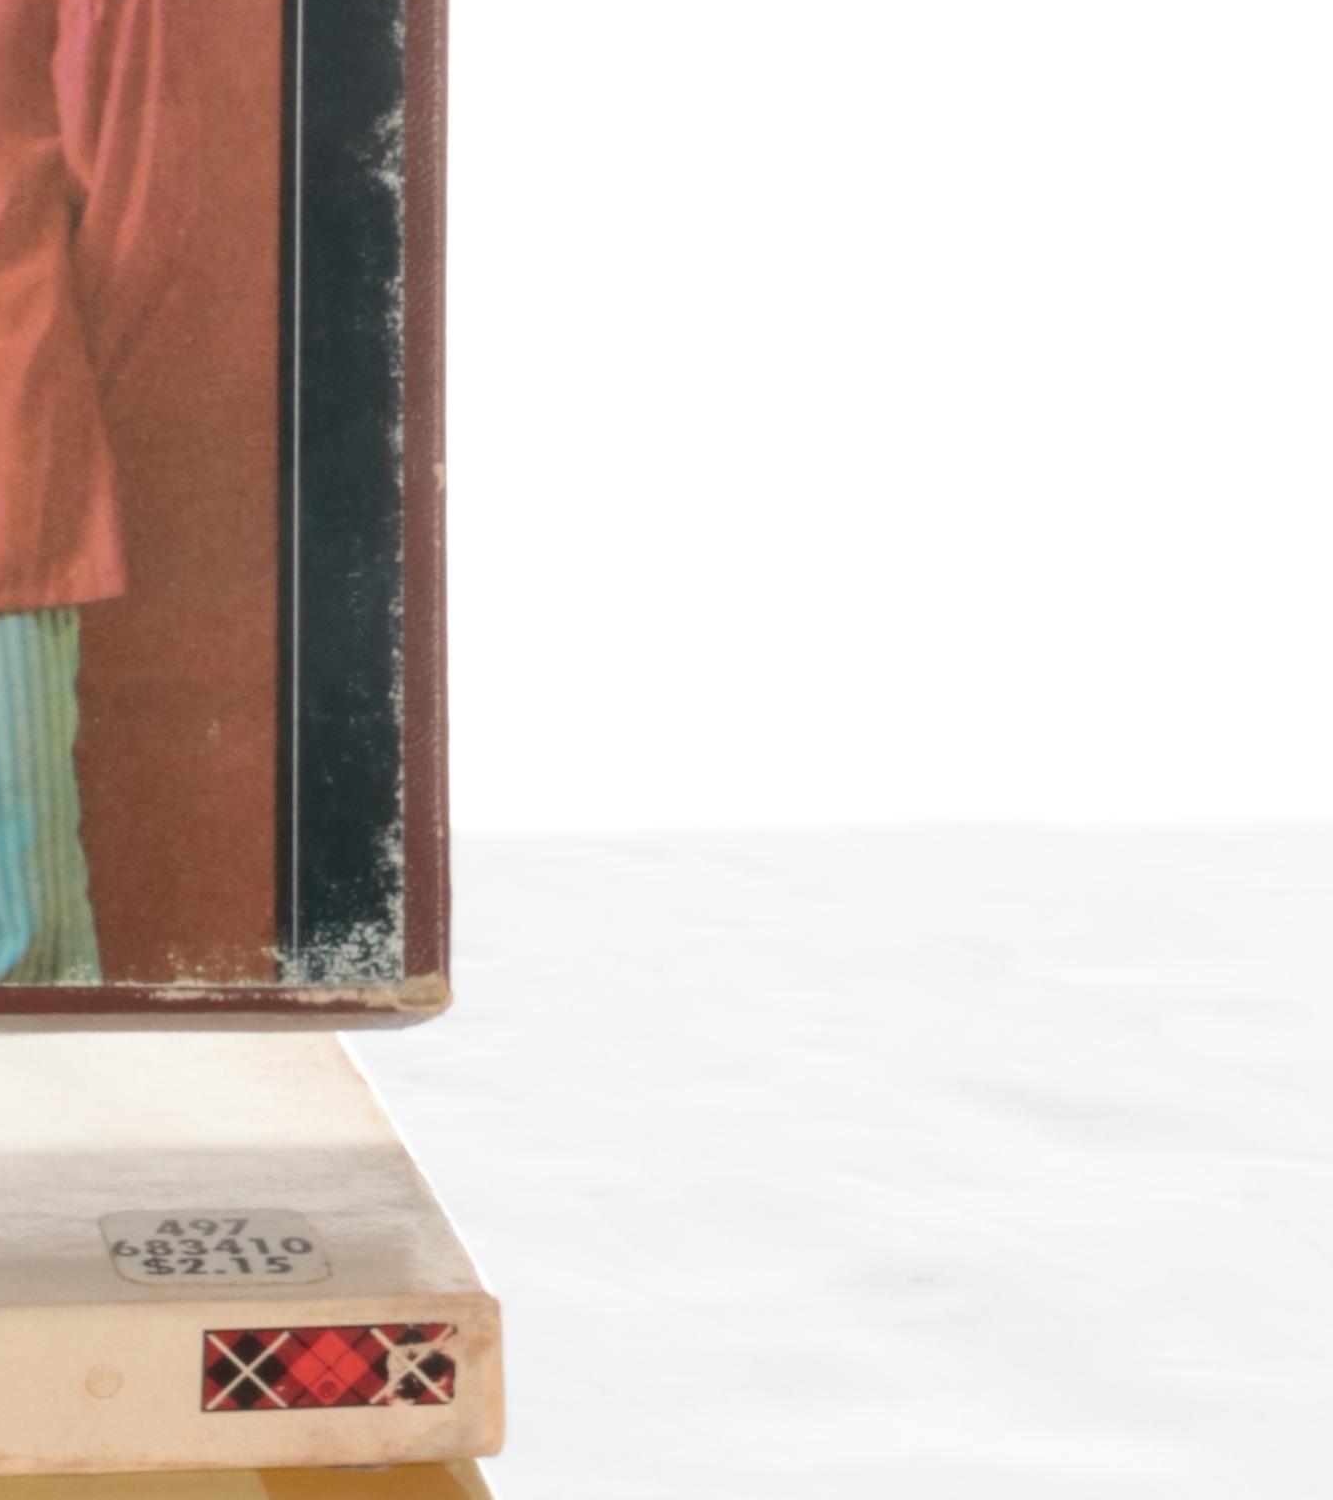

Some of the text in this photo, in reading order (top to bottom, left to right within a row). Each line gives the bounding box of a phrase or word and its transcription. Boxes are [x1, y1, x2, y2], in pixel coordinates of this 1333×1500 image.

[155, 1218, 250, 1238] 497
[110, 1236, 314, 1258] 683410
[141, 1257, 294, 1276] $2.15
